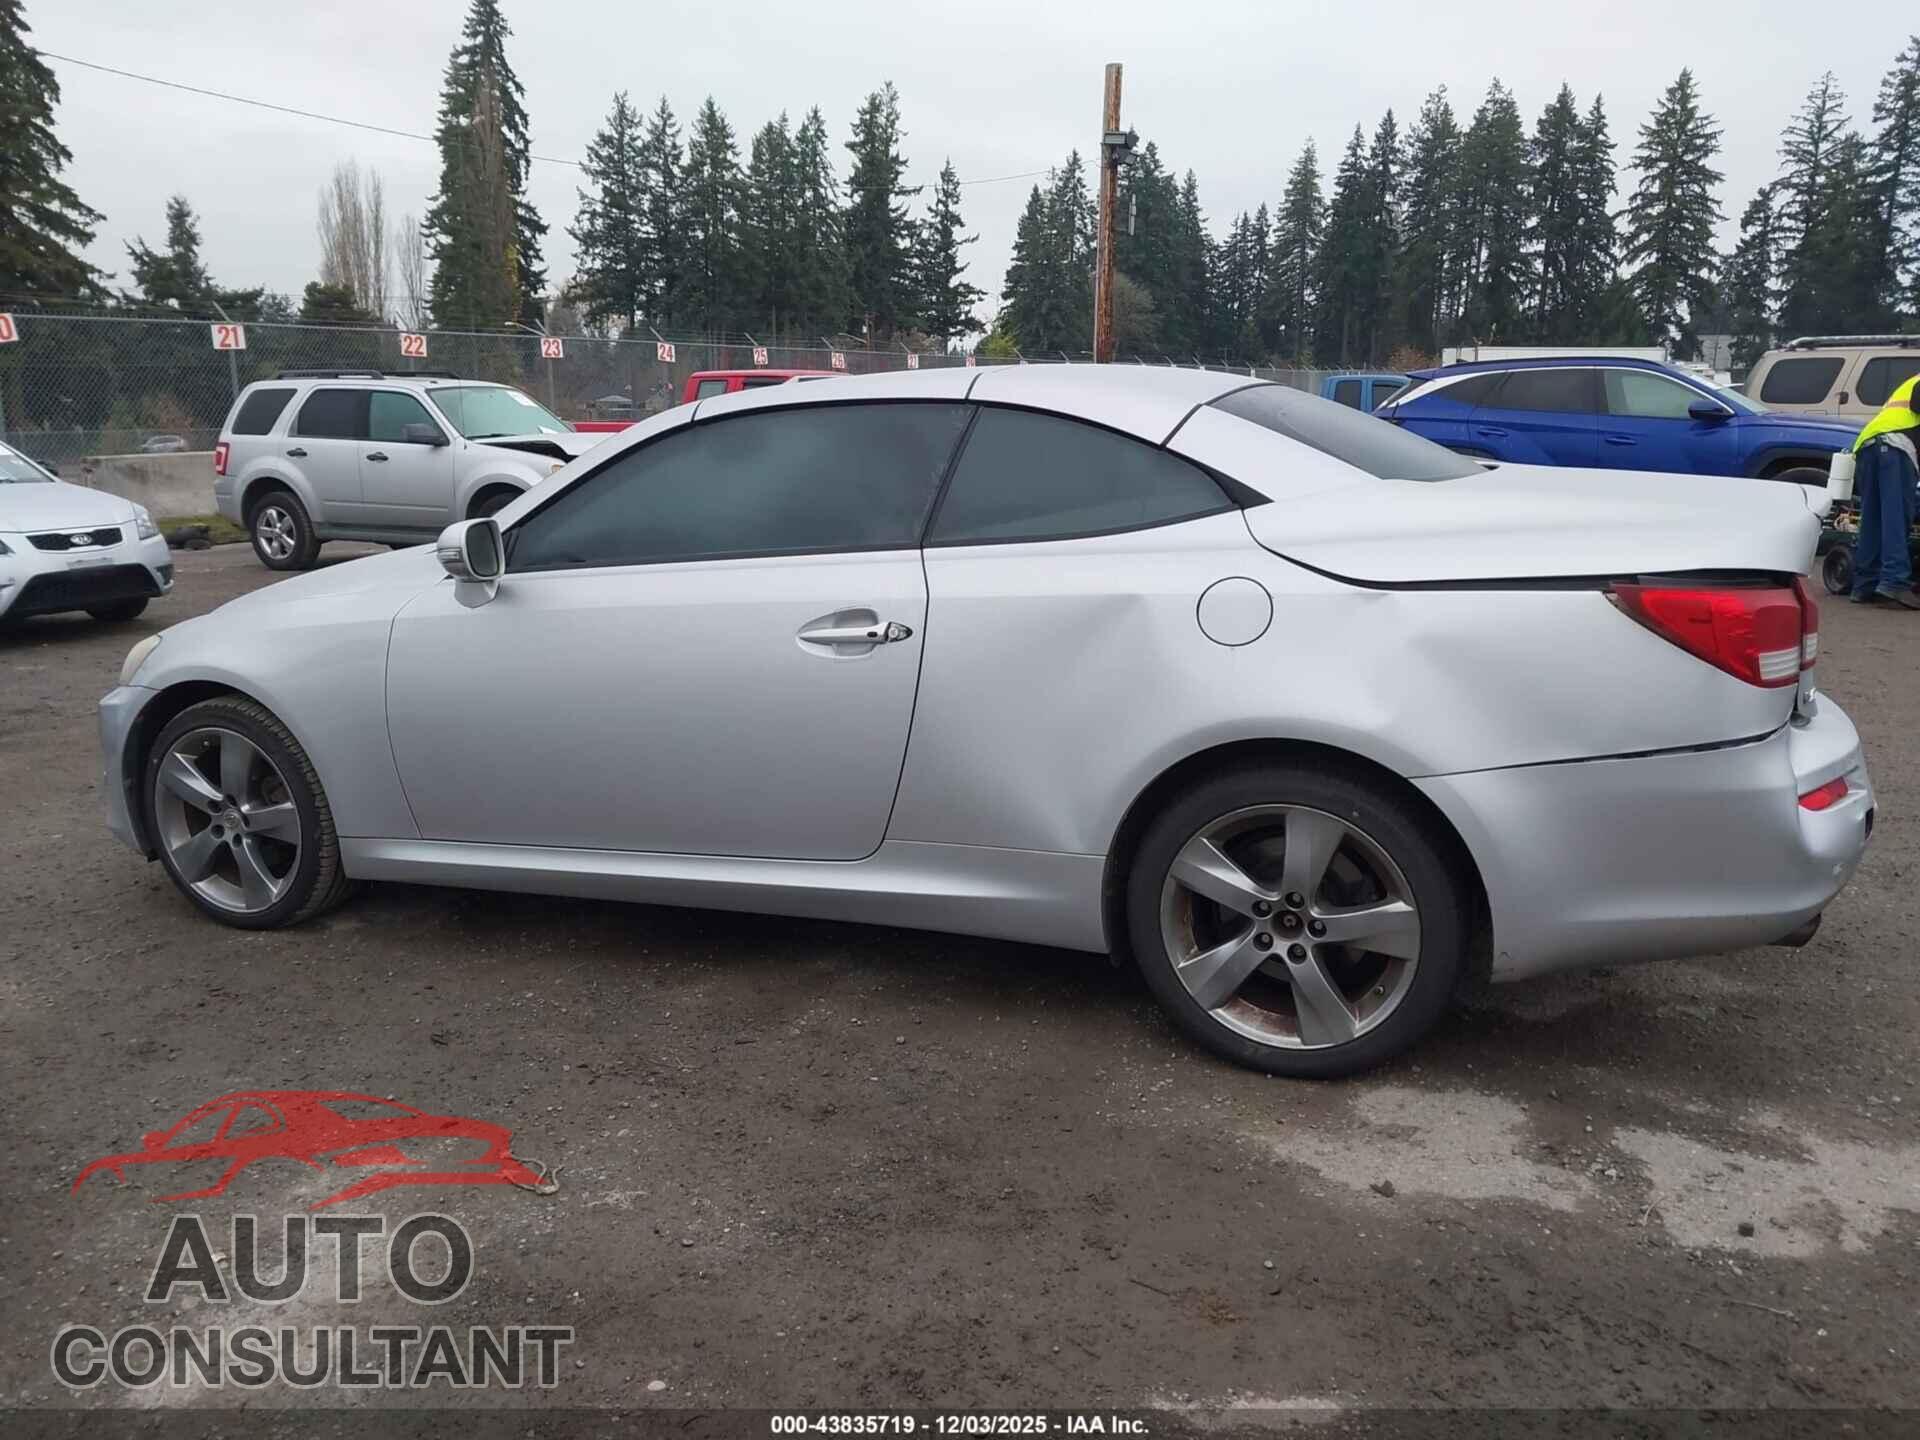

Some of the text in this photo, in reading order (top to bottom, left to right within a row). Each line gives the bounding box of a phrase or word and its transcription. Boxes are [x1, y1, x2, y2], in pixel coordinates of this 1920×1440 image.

[217, 326, 240, 347] 21
[403, 335, 424, 355] 22
[543, 340, 561, 356] 23
[659, 344, 673, 360] 24
[754, 349, 767, 364] 25
